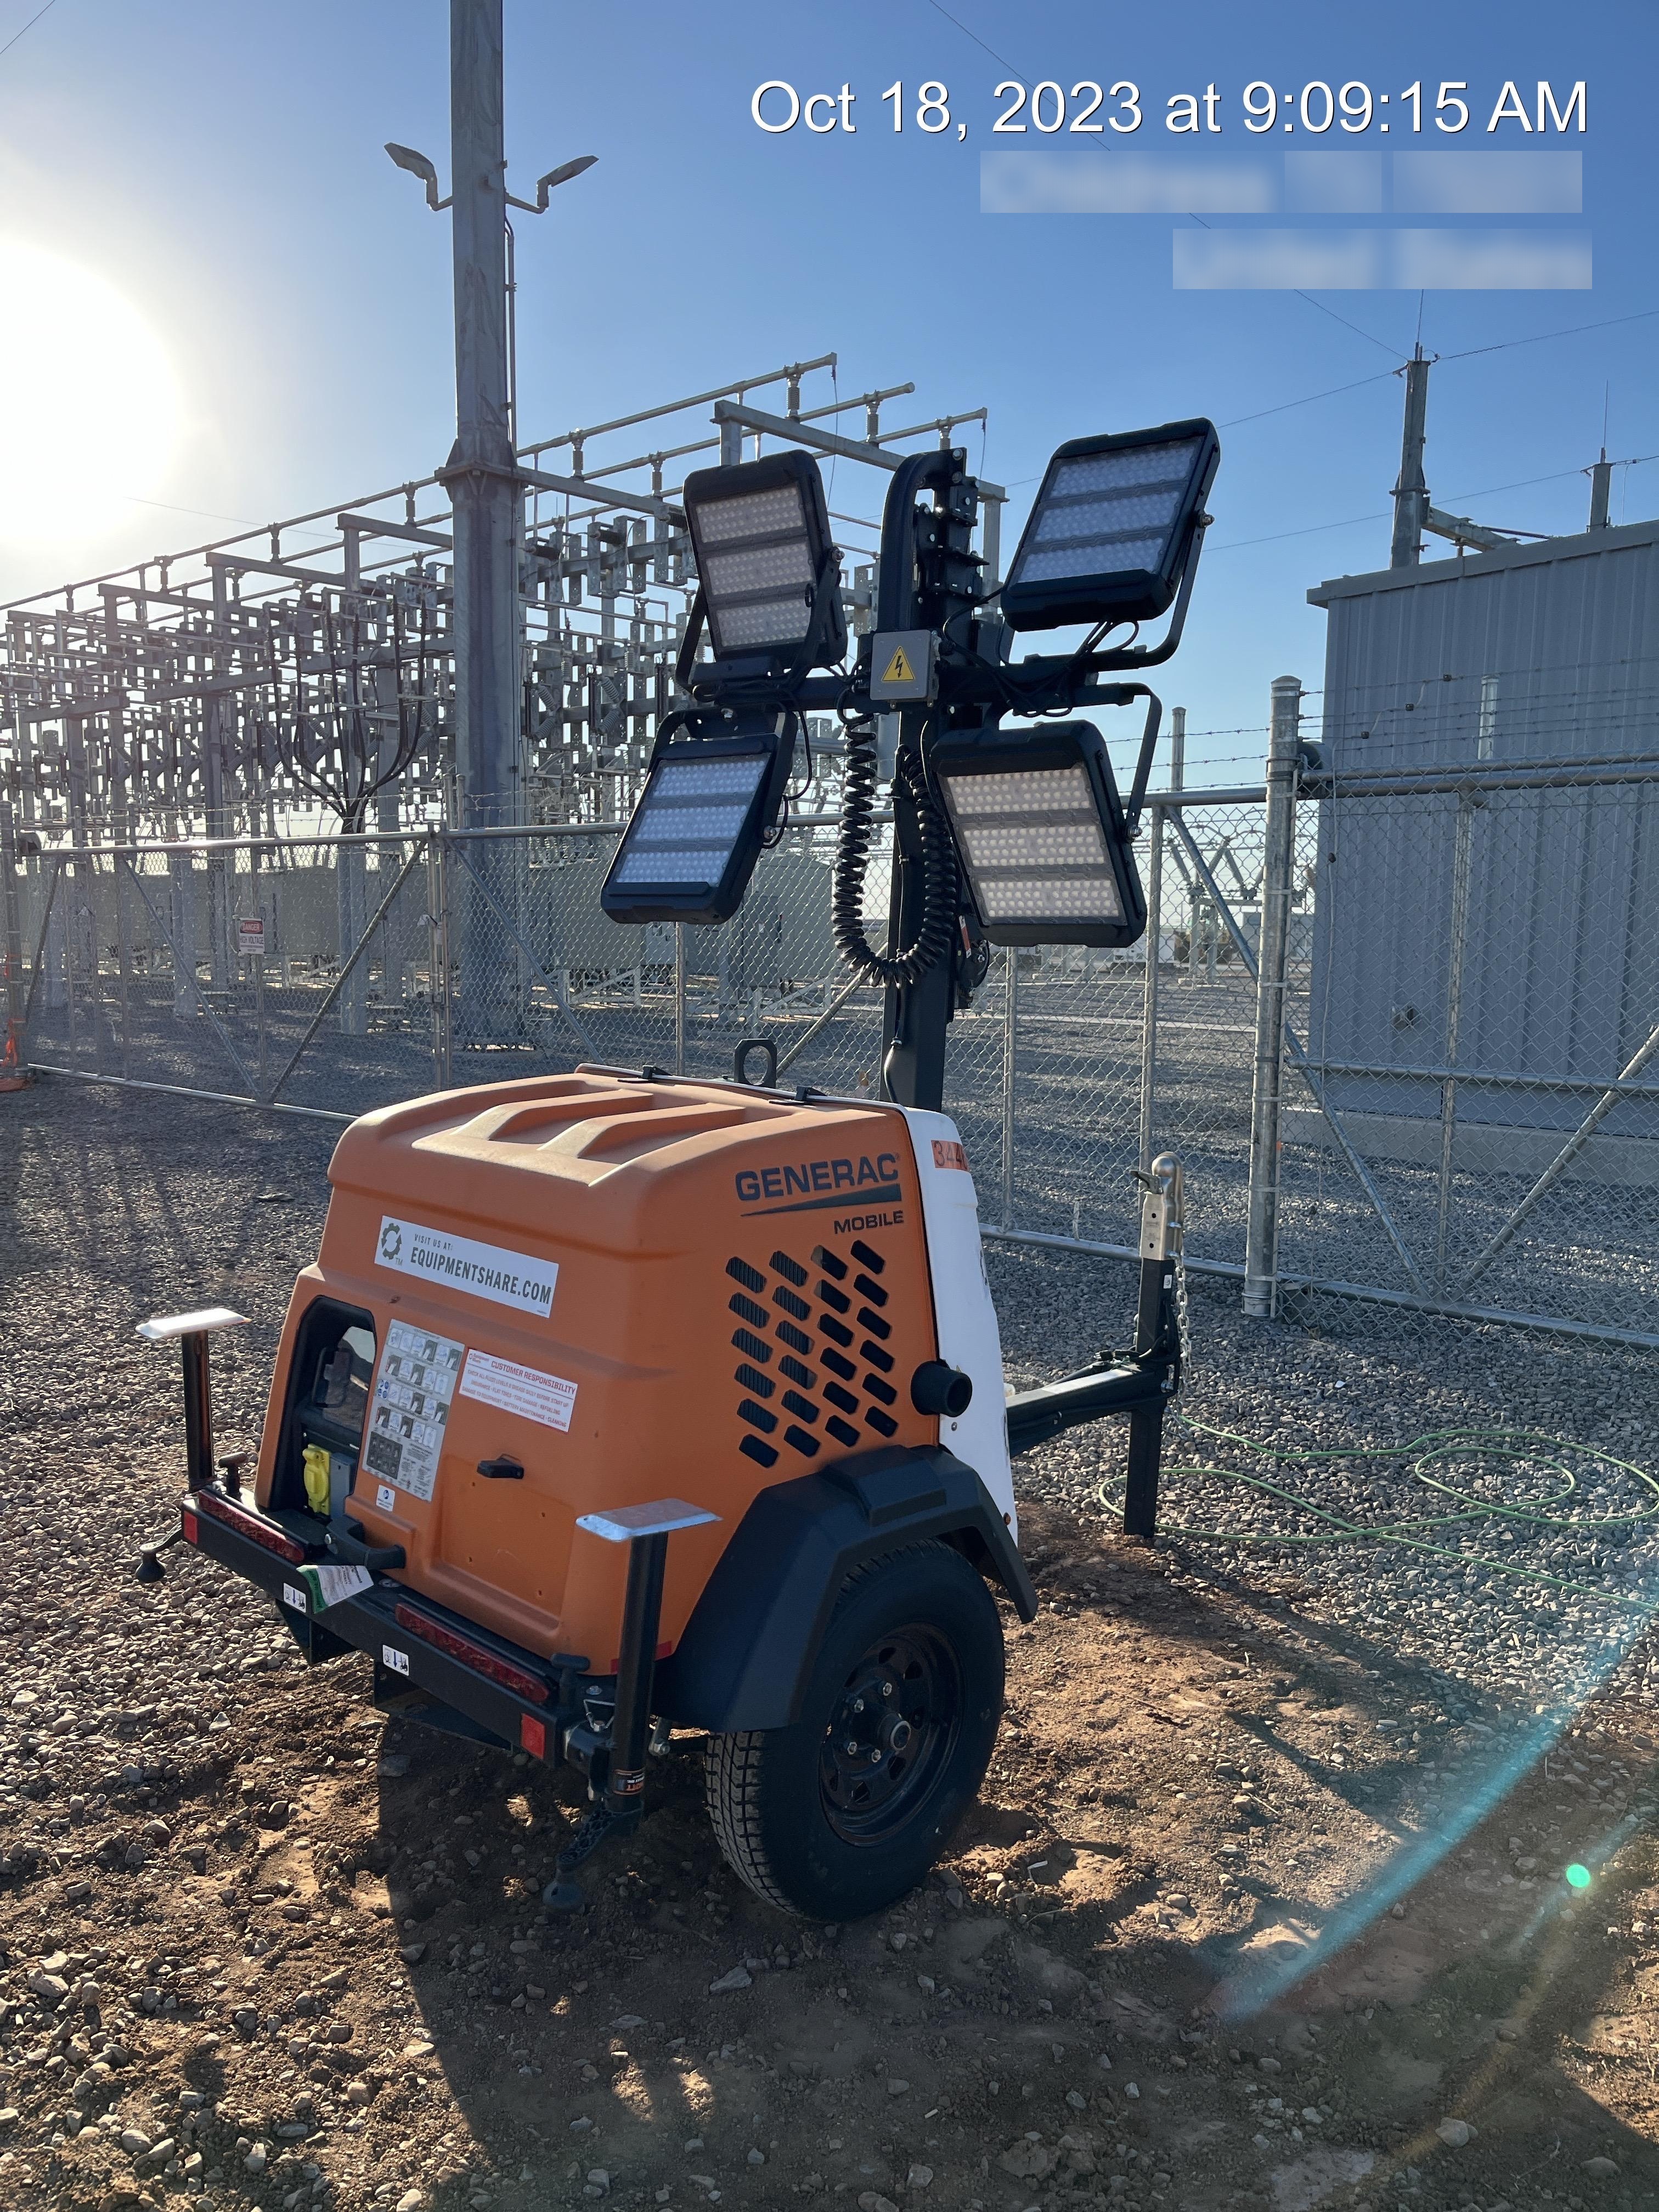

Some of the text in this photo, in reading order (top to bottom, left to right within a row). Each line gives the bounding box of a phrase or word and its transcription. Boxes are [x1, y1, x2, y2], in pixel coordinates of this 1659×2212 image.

[241, 922, 261, 931] DANGER
[249, 936, 264, 945] VOLTAGE
[735, 1153, 899, 1201] GENERAC
[834, 1210, 904, 1234] MOBILE
[414, 1233, 431, 1245] VISIT
[433, 1239, 441, 1248] US
[395, 1257, 403, 1266] TM
[410, 1246, 552, 1305] EQUIPMENTSHARE.COM
[491, 1361, 575, 1395] CUSTOMER RESPONSIBILITY
